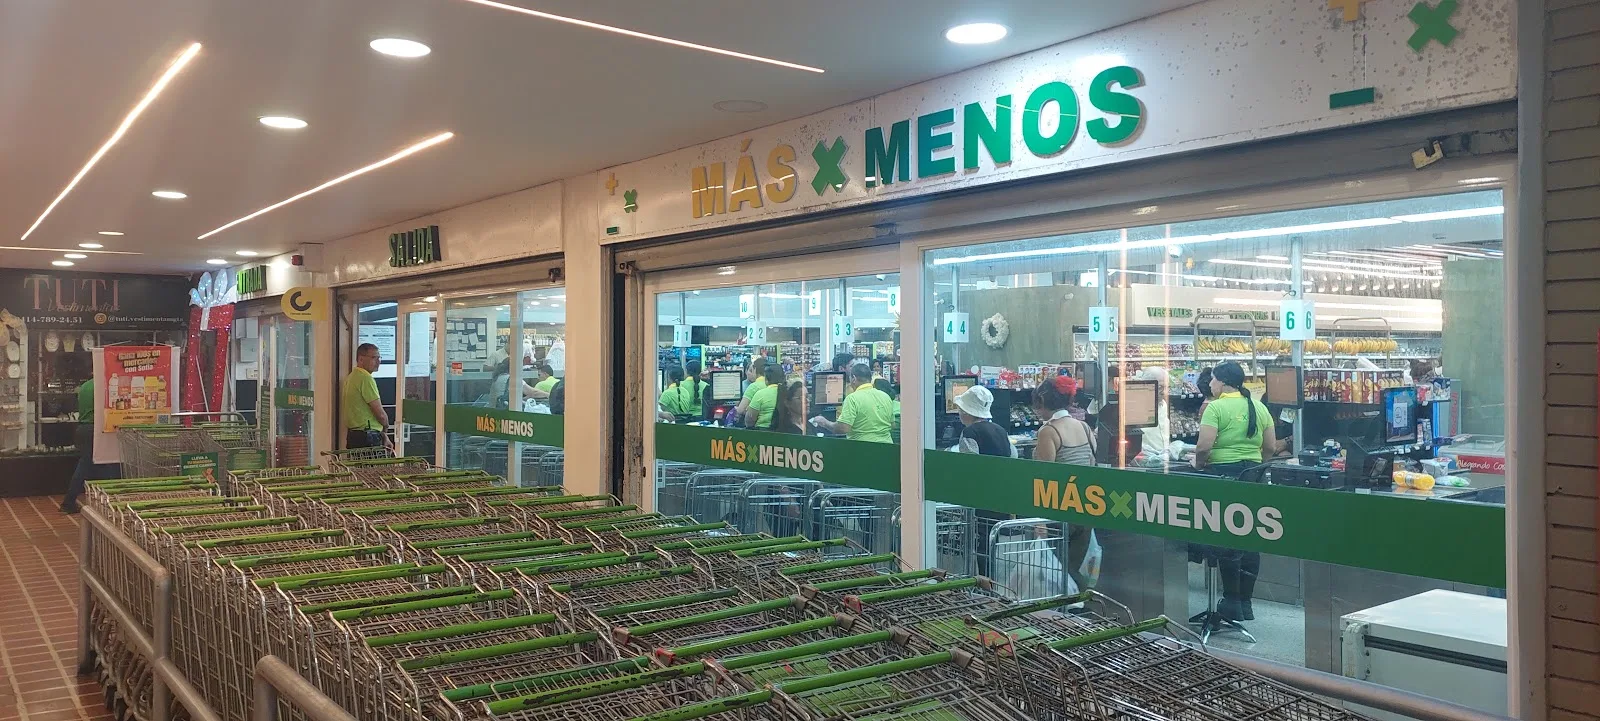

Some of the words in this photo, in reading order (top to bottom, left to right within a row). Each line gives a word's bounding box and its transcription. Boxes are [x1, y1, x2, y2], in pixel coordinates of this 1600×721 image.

[691, 139, 799, 219] MÁS
[865, 65, 1146, 188] MENOS
[389, 225, 439, 267] SALIDA
[24, 275, 120, 310] TUTI
[947, 321, 953, 335] 4
[960, 321, 966, 335] 4
[1093, 316, 1100, 332] 5
[1109, 317, 1115, 332] 5
[1286, 311, 1295, 330] 6
[1306, 311, 1312, 330] 6
[749, 327, 754, 339] 2
[758, 327, 764, 339] 2
[835, 323, 840, 336] 3
[845, 323, 851, 336] 3
[476, 414, 495, 433] MÁS
[501, 419, 534, 437] MENOS
[711, 436, 746, 463] MÁS
[760, 445, 824, 473] MENOS
[1033, 476, 1107, 516] MÁS
[1136, 491, 1284, 541] MENOS
